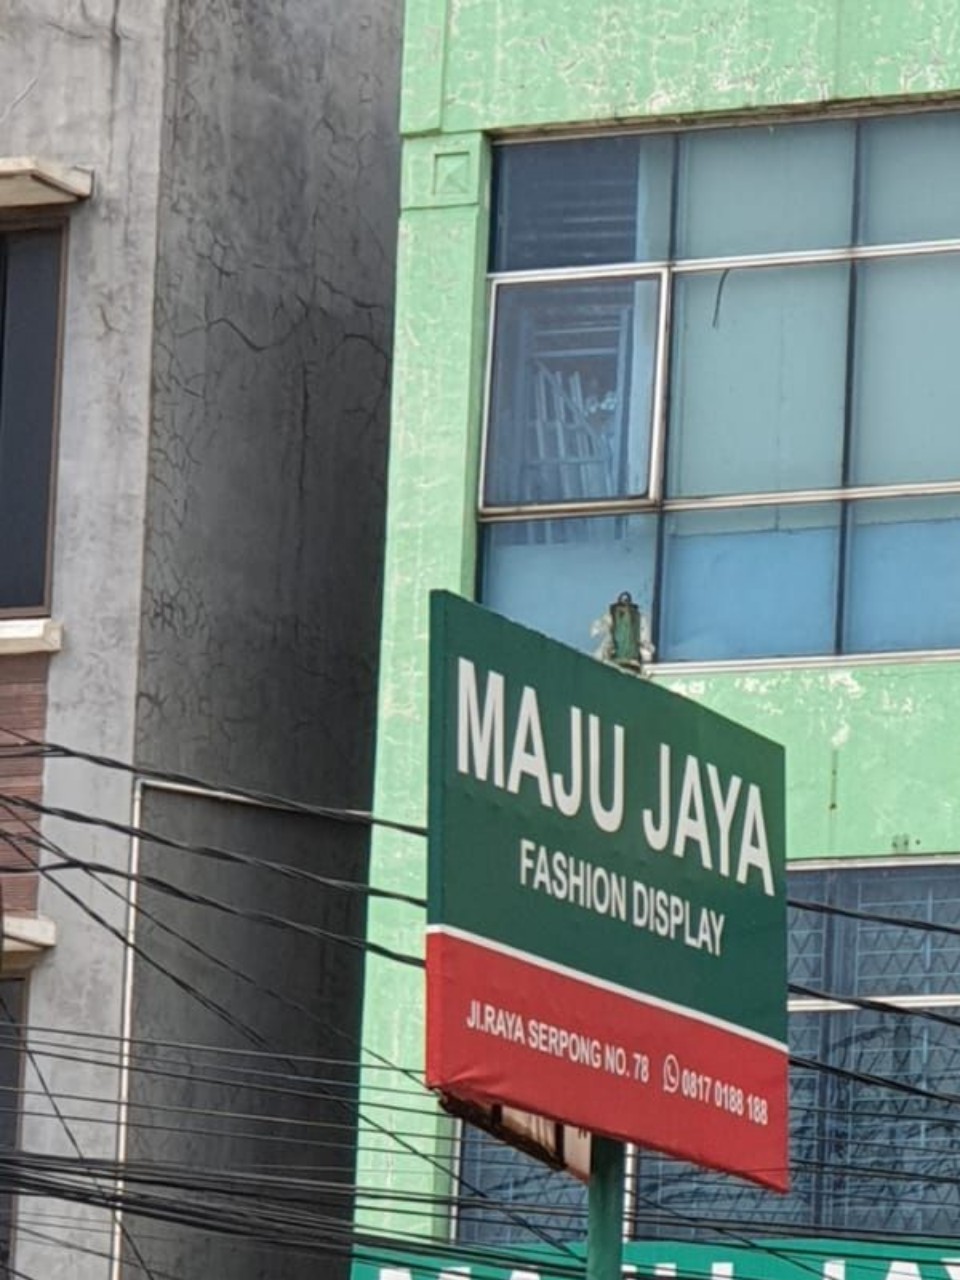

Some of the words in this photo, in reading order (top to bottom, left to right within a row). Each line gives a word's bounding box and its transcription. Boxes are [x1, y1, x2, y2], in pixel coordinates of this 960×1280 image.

[457, 656, 625, 834] MAJU
[642, 742, 775, 897] JAYA
[520, 838, 627, 922] FASHION
[633, 881, 725, 957] DISPLAY
[528, 1019, 601, 1069] SERPONG
[604, 1046, 630, 1078] NO.
[633, 1052, 650, 1084] 78
[681, 1068, 711, 1103] 0817
[715, 1083, 744, 1117] 0188
[747, 1092, 768, 1126] 188
